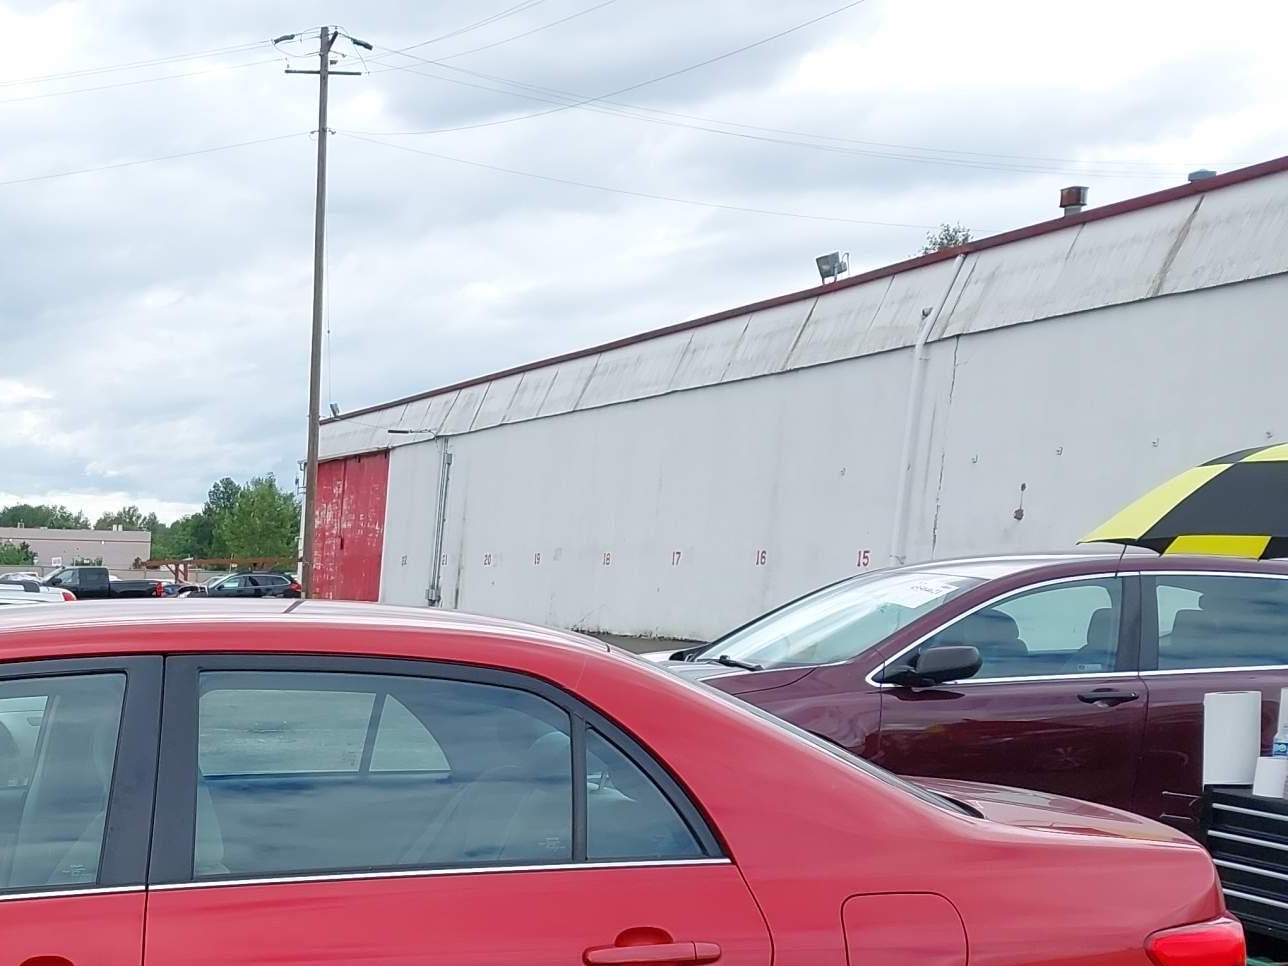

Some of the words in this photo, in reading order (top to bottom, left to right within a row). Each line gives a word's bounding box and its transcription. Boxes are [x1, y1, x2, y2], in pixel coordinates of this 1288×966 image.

[483, 554, 492, 566] 20
[671, 551, 681, 566] 17
[756, 550, 767, 565] 16
[857, 550, 870, 567] 15
